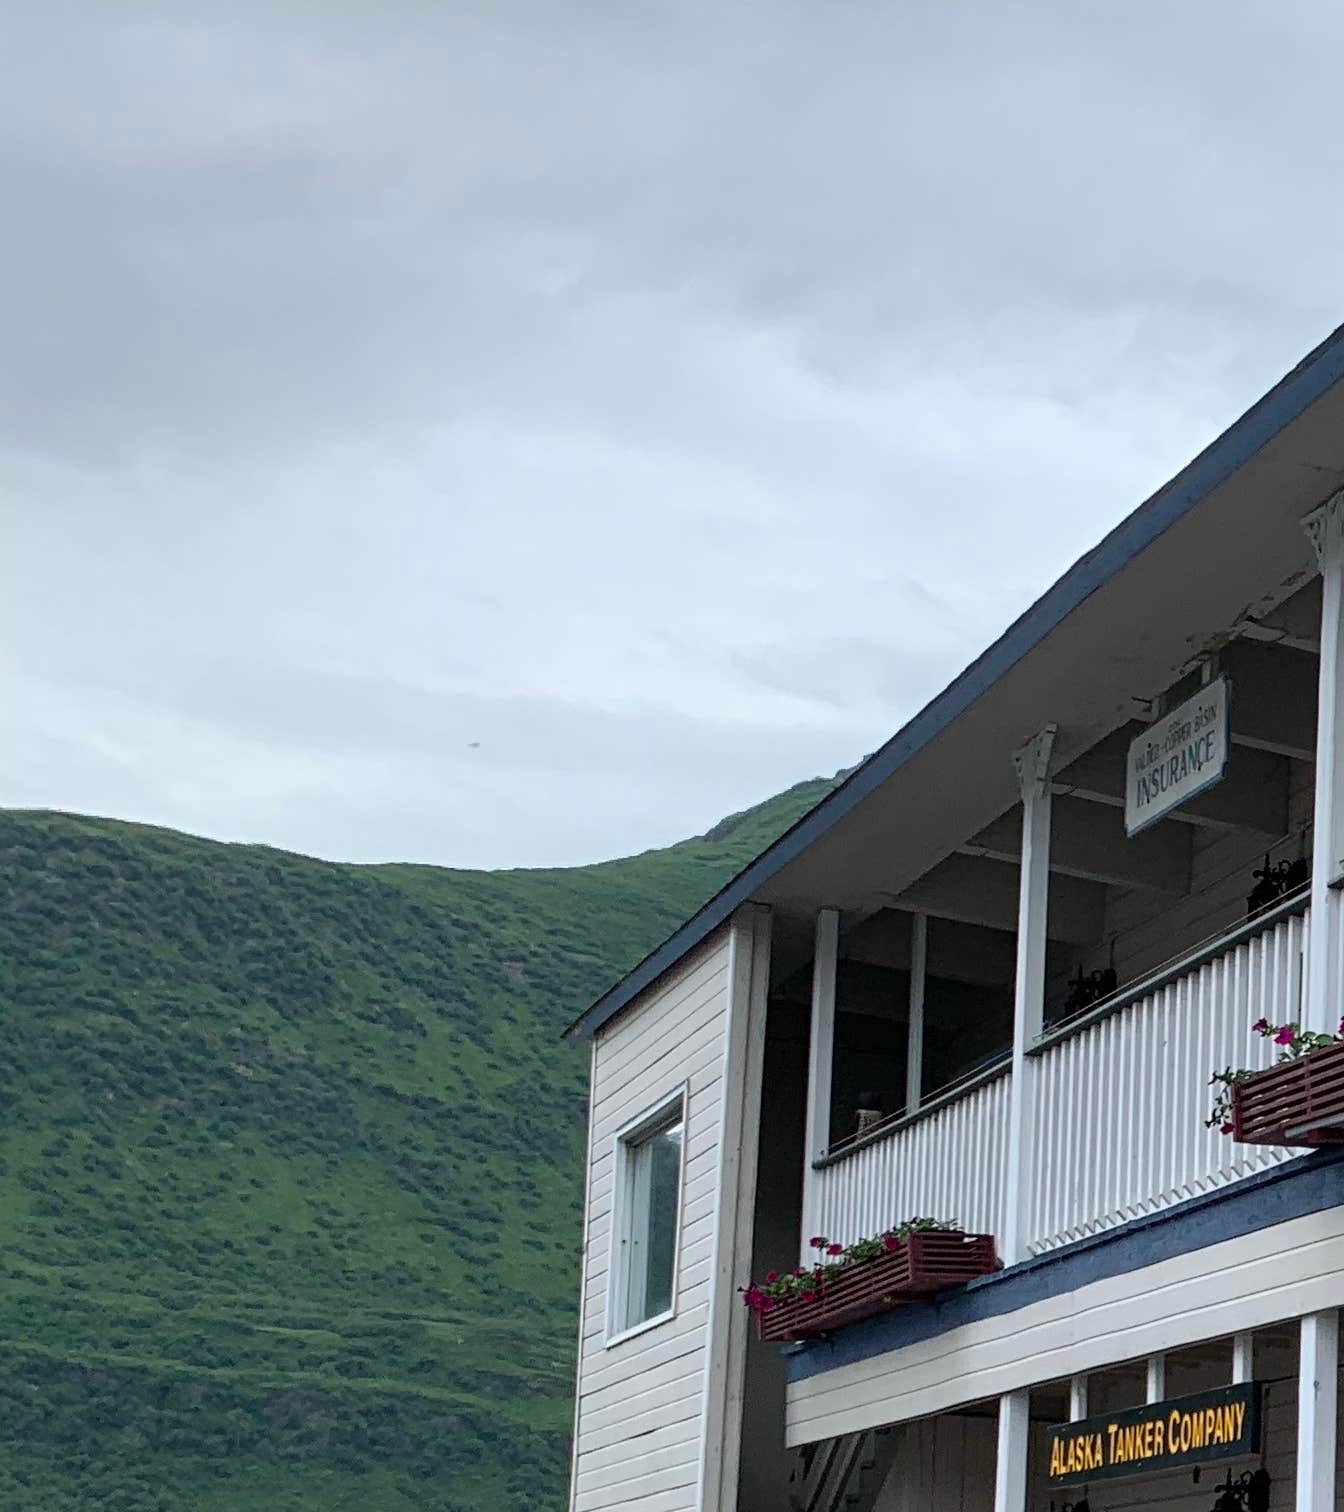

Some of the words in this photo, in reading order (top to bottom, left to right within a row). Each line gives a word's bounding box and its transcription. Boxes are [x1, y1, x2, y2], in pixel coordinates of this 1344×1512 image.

[1136, 729, 1215, 809] INSURANCE
[1049, 1435, 1103, 1478] ALASKA
[1107, 1423, 1165, 1465] TANKER
[1167, 1400, 1247, 1455] COMPANY
